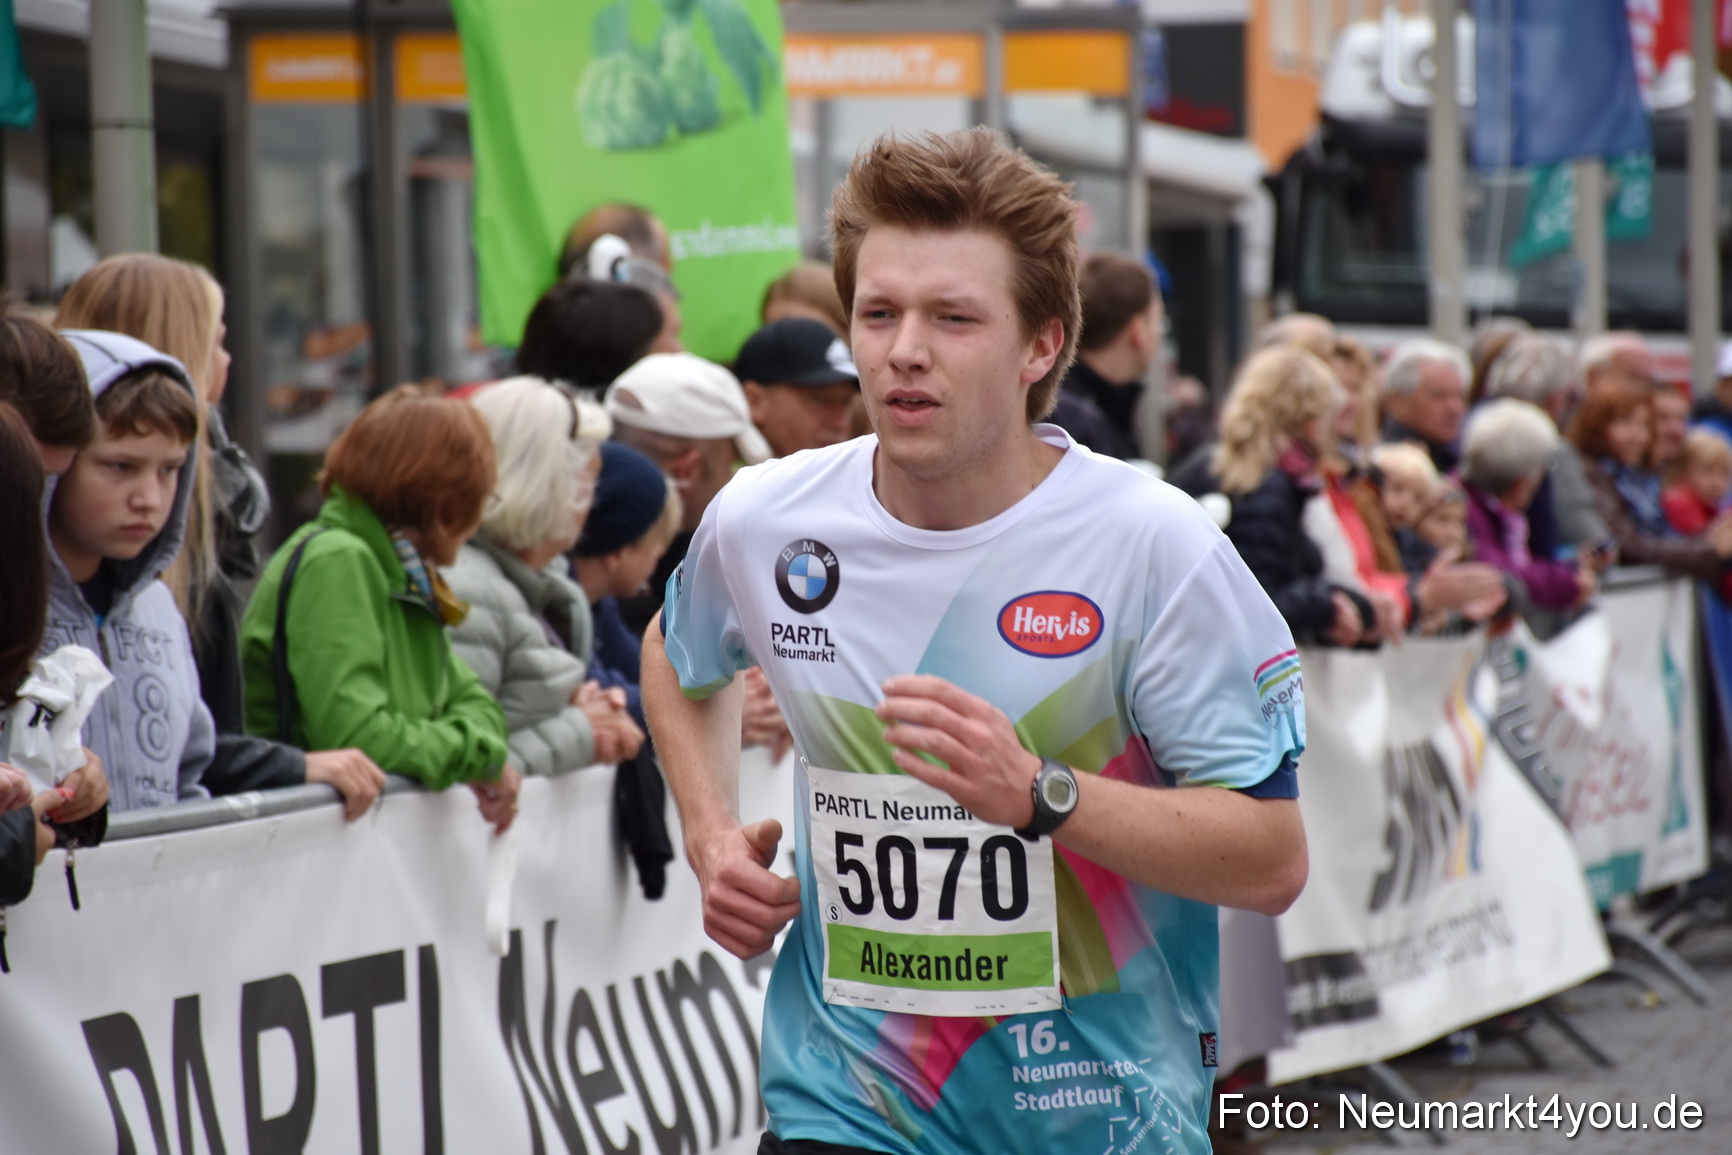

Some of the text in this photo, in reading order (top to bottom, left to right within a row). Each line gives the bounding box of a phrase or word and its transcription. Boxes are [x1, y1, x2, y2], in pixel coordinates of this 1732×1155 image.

[782, 540, 837, 568] BMW
[771, 622, 835, 648] PARTL
[1013, 606, 1091, 641] Hervis
[772, 642, 836, 663] Neumarkt
[1016, 634, 1055, 643] SPORTS
[814, 792, 877, 820] PARTL
[834, 831, 1030, 921] 5070
[860, 941, 1009, 981] Alexander
[1007, 1020, 1070, 1058] 16.
[1014, 1085, 1124, 1112] Stadtlauf
[1119, 1111, 1158, 1155] September
